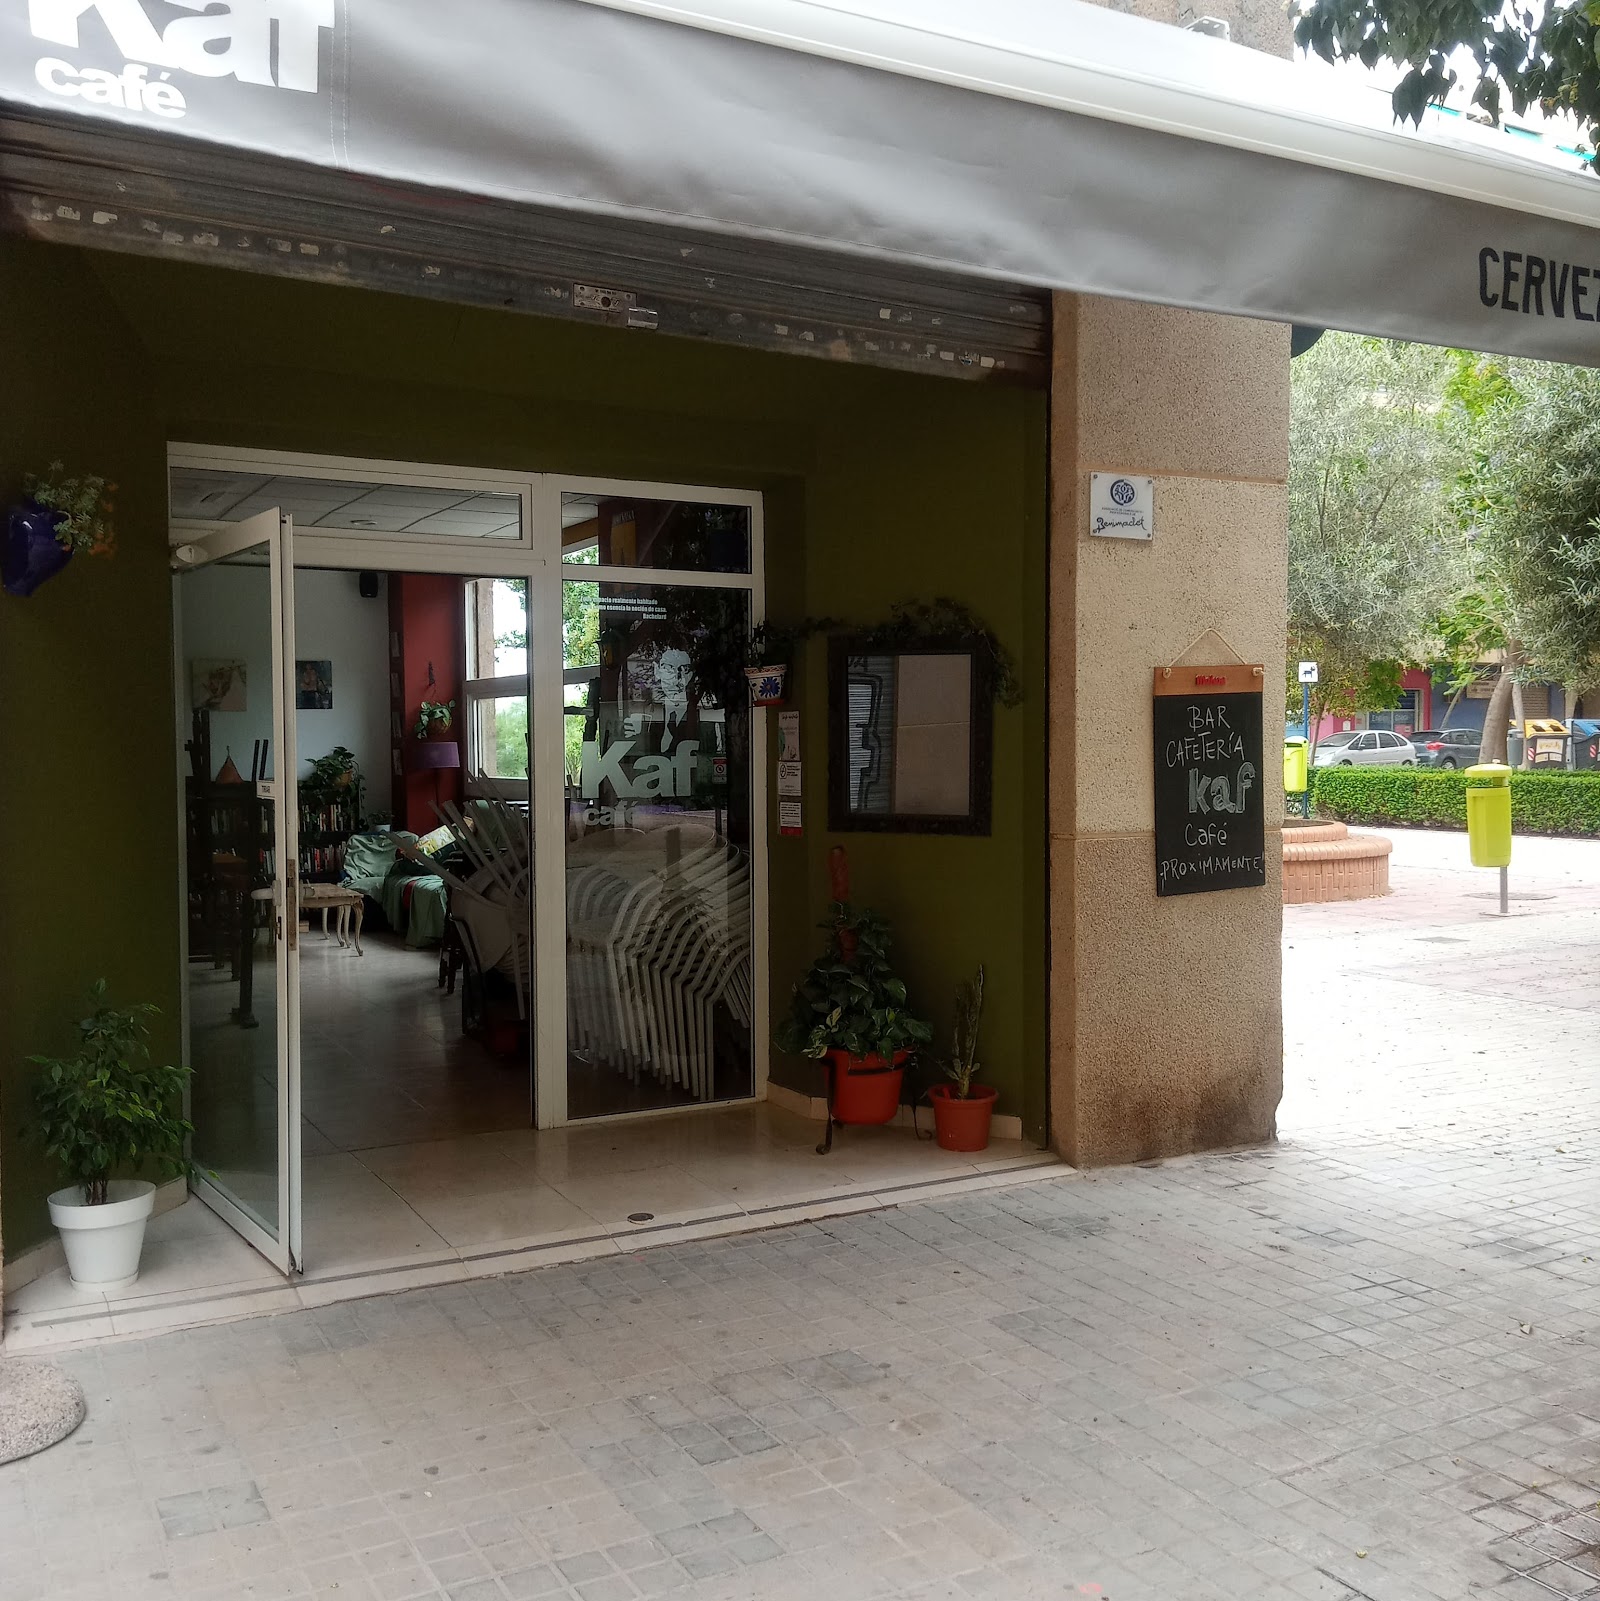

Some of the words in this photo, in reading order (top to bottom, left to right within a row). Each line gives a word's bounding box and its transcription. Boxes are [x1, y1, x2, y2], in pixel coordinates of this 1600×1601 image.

[34, 57, 187, 119] café
[1187, 705, 1230, 732] BAR
[1166, 731, 1245, 768] CAFETERÍA
[582, 740, 700, 799] Kaf
[583, 800, 640, 826] café
[1185, 822, 1227, 847] Café
